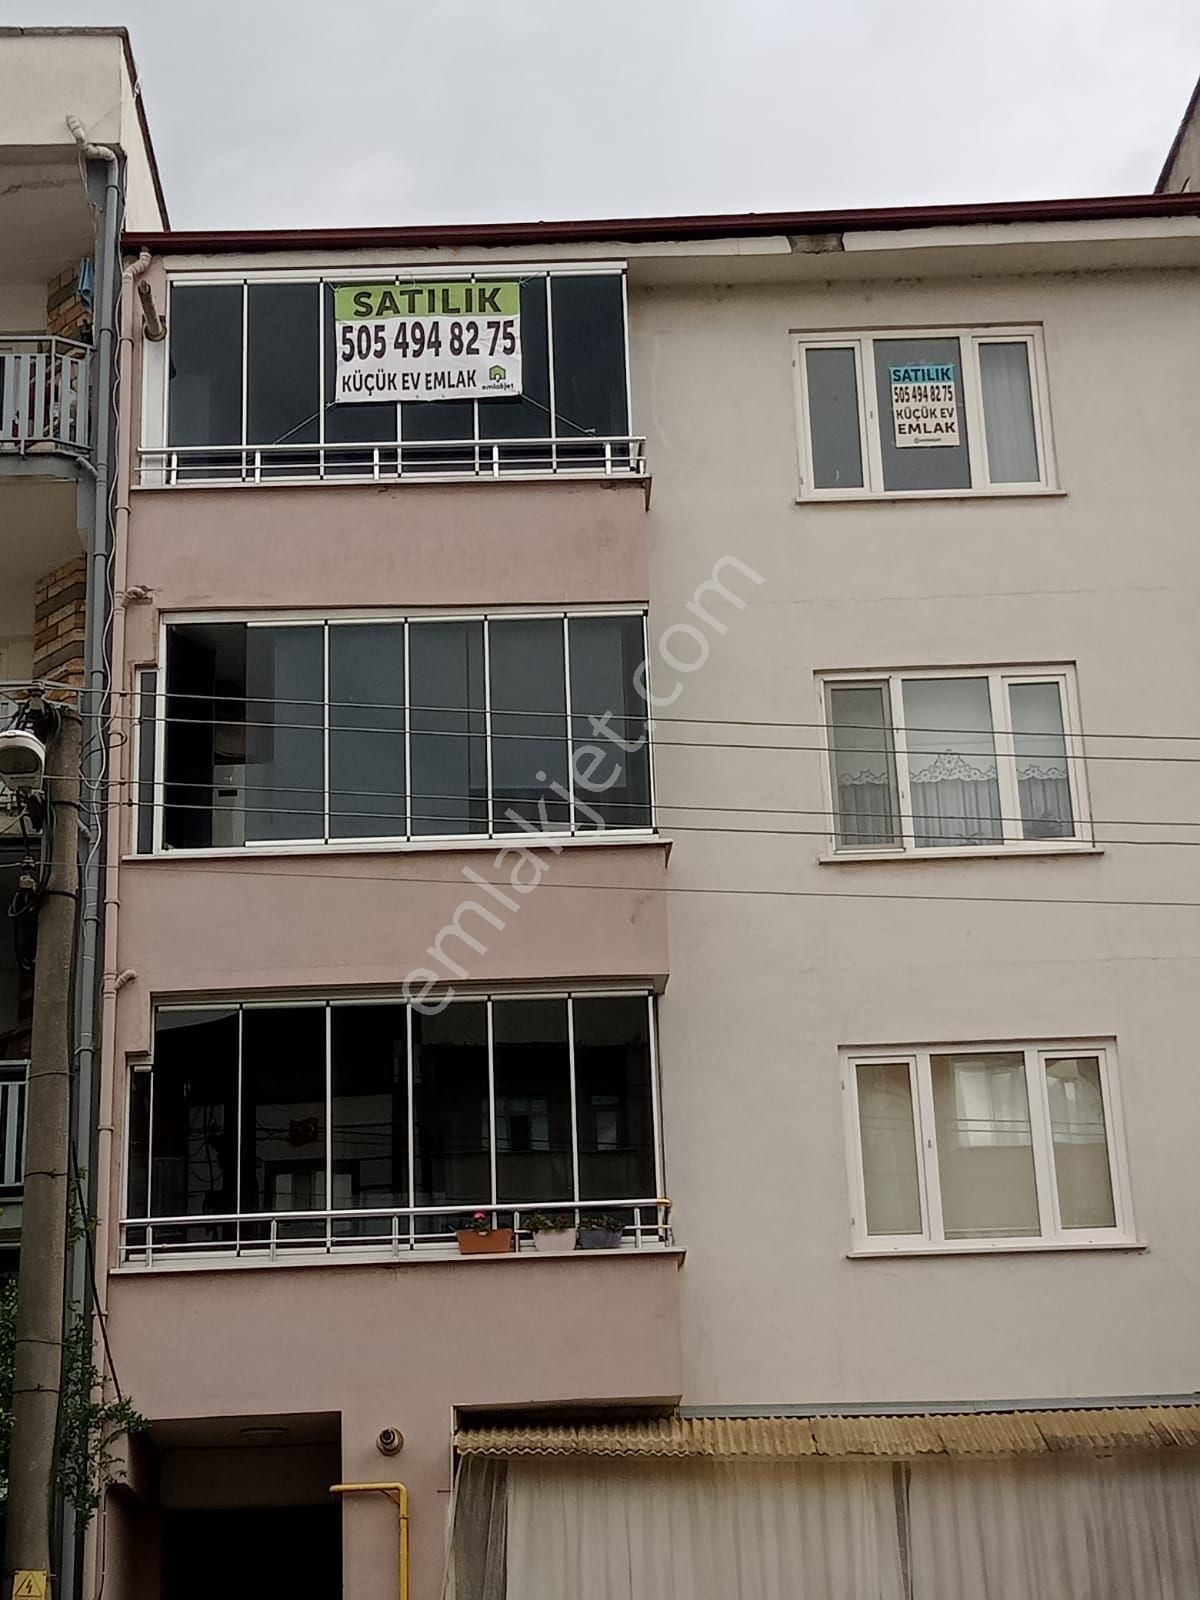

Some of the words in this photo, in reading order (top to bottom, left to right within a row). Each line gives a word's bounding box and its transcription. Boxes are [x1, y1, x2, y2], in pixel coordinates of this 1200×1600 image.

[353, 287, 502, 317] SATILIK
[341, 324, 387, 362] 505
[393, 321, 442, 359] 494
[449, 321, 480, 357] 82
[486, 319, 517, 357] 75
[342, 368, 398, 397] KÜÇÜK
[401, 372, 421, 391] EV
[425, 369, 477, 391] EMLAK
[892, 367, 952, 382] SATILIK
[894, 386, 911, 403] 505
[911, 385, 929, 403] 494
[929, 385, 942, 402] 82
[942, 384, 954, 402] 75
[895, 405, 938, 422] KÜÇÜK
[940, 407, 955, 419] EV
[897, 422, 956, 435] EMLAK
